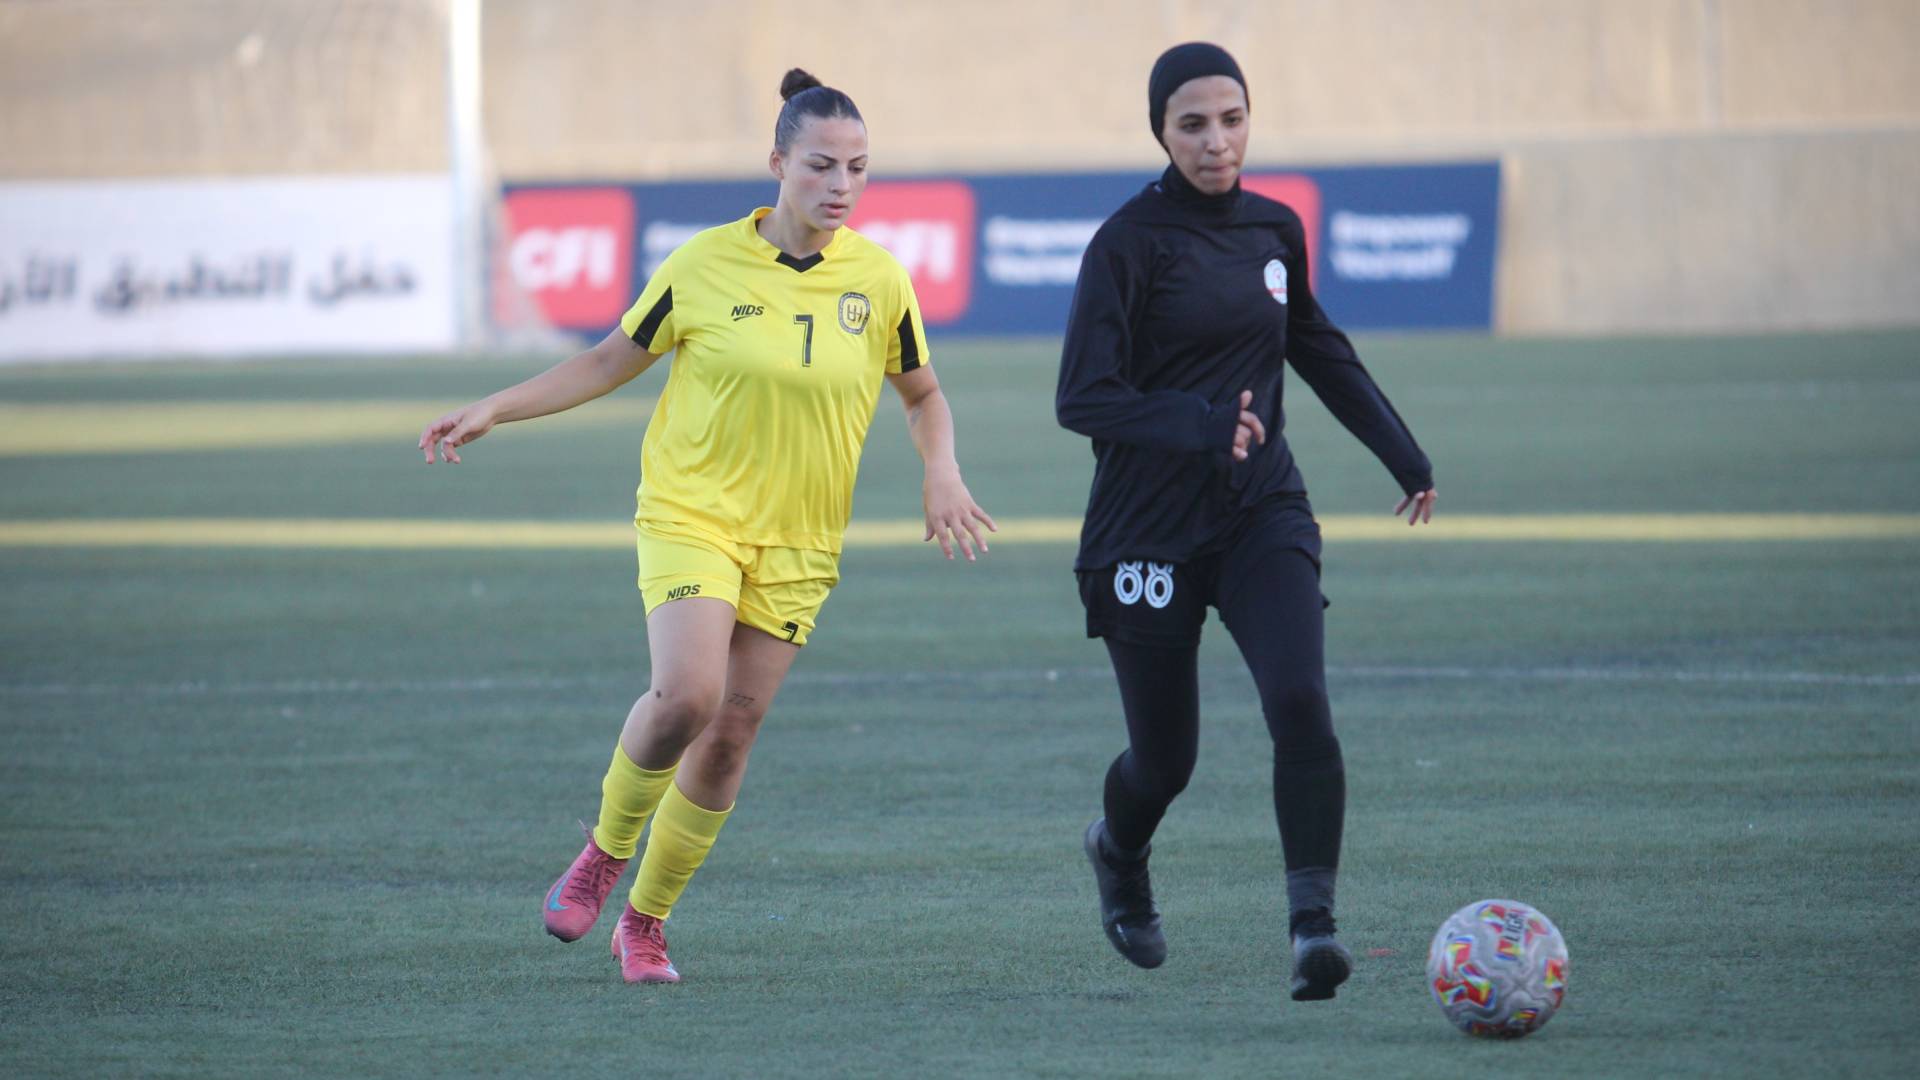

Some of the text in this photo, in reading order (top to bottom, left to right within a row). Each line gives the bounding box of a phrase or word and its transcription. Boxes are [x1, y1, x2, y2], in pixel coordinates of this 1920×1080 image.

[511, 227, 615, 290] CFI
[731, 304, 764, 318] NIDS
[793, 313, 813, 367] 7
[666, 583, 702, 602] NIDS
[1114, 560, 1174, 609] 88
